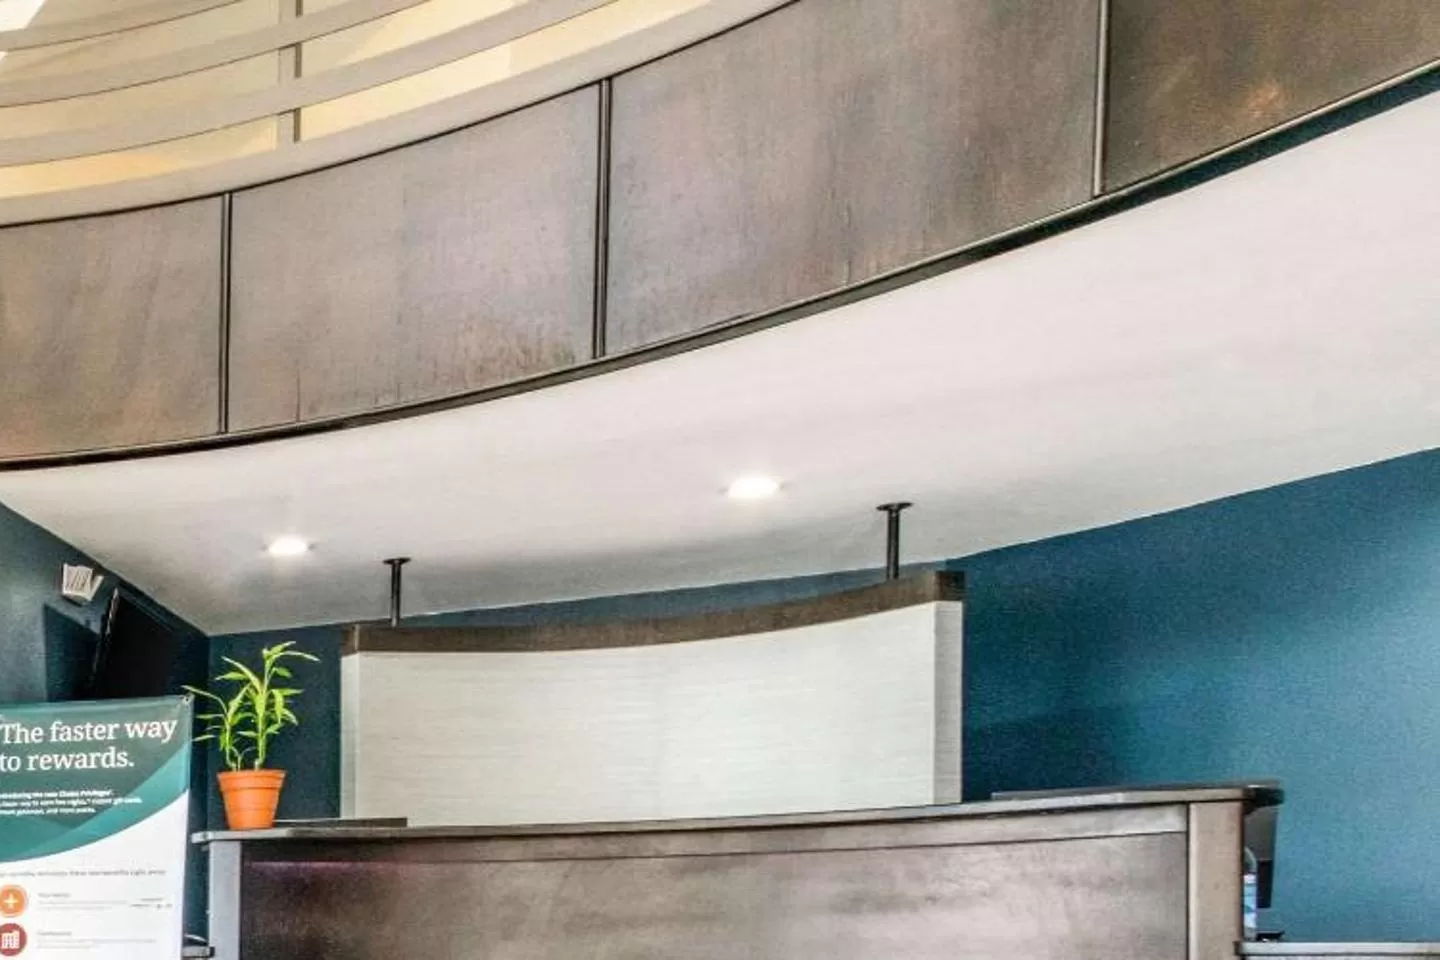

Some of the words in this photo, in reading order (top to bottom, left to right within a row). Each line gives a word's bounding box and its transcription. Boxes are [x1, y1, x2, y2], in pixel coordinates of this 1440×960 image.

[50, 720, 120, 743] faster
[125, 718, 178, 743] way
[27, 746, 135, 771] rewards.
